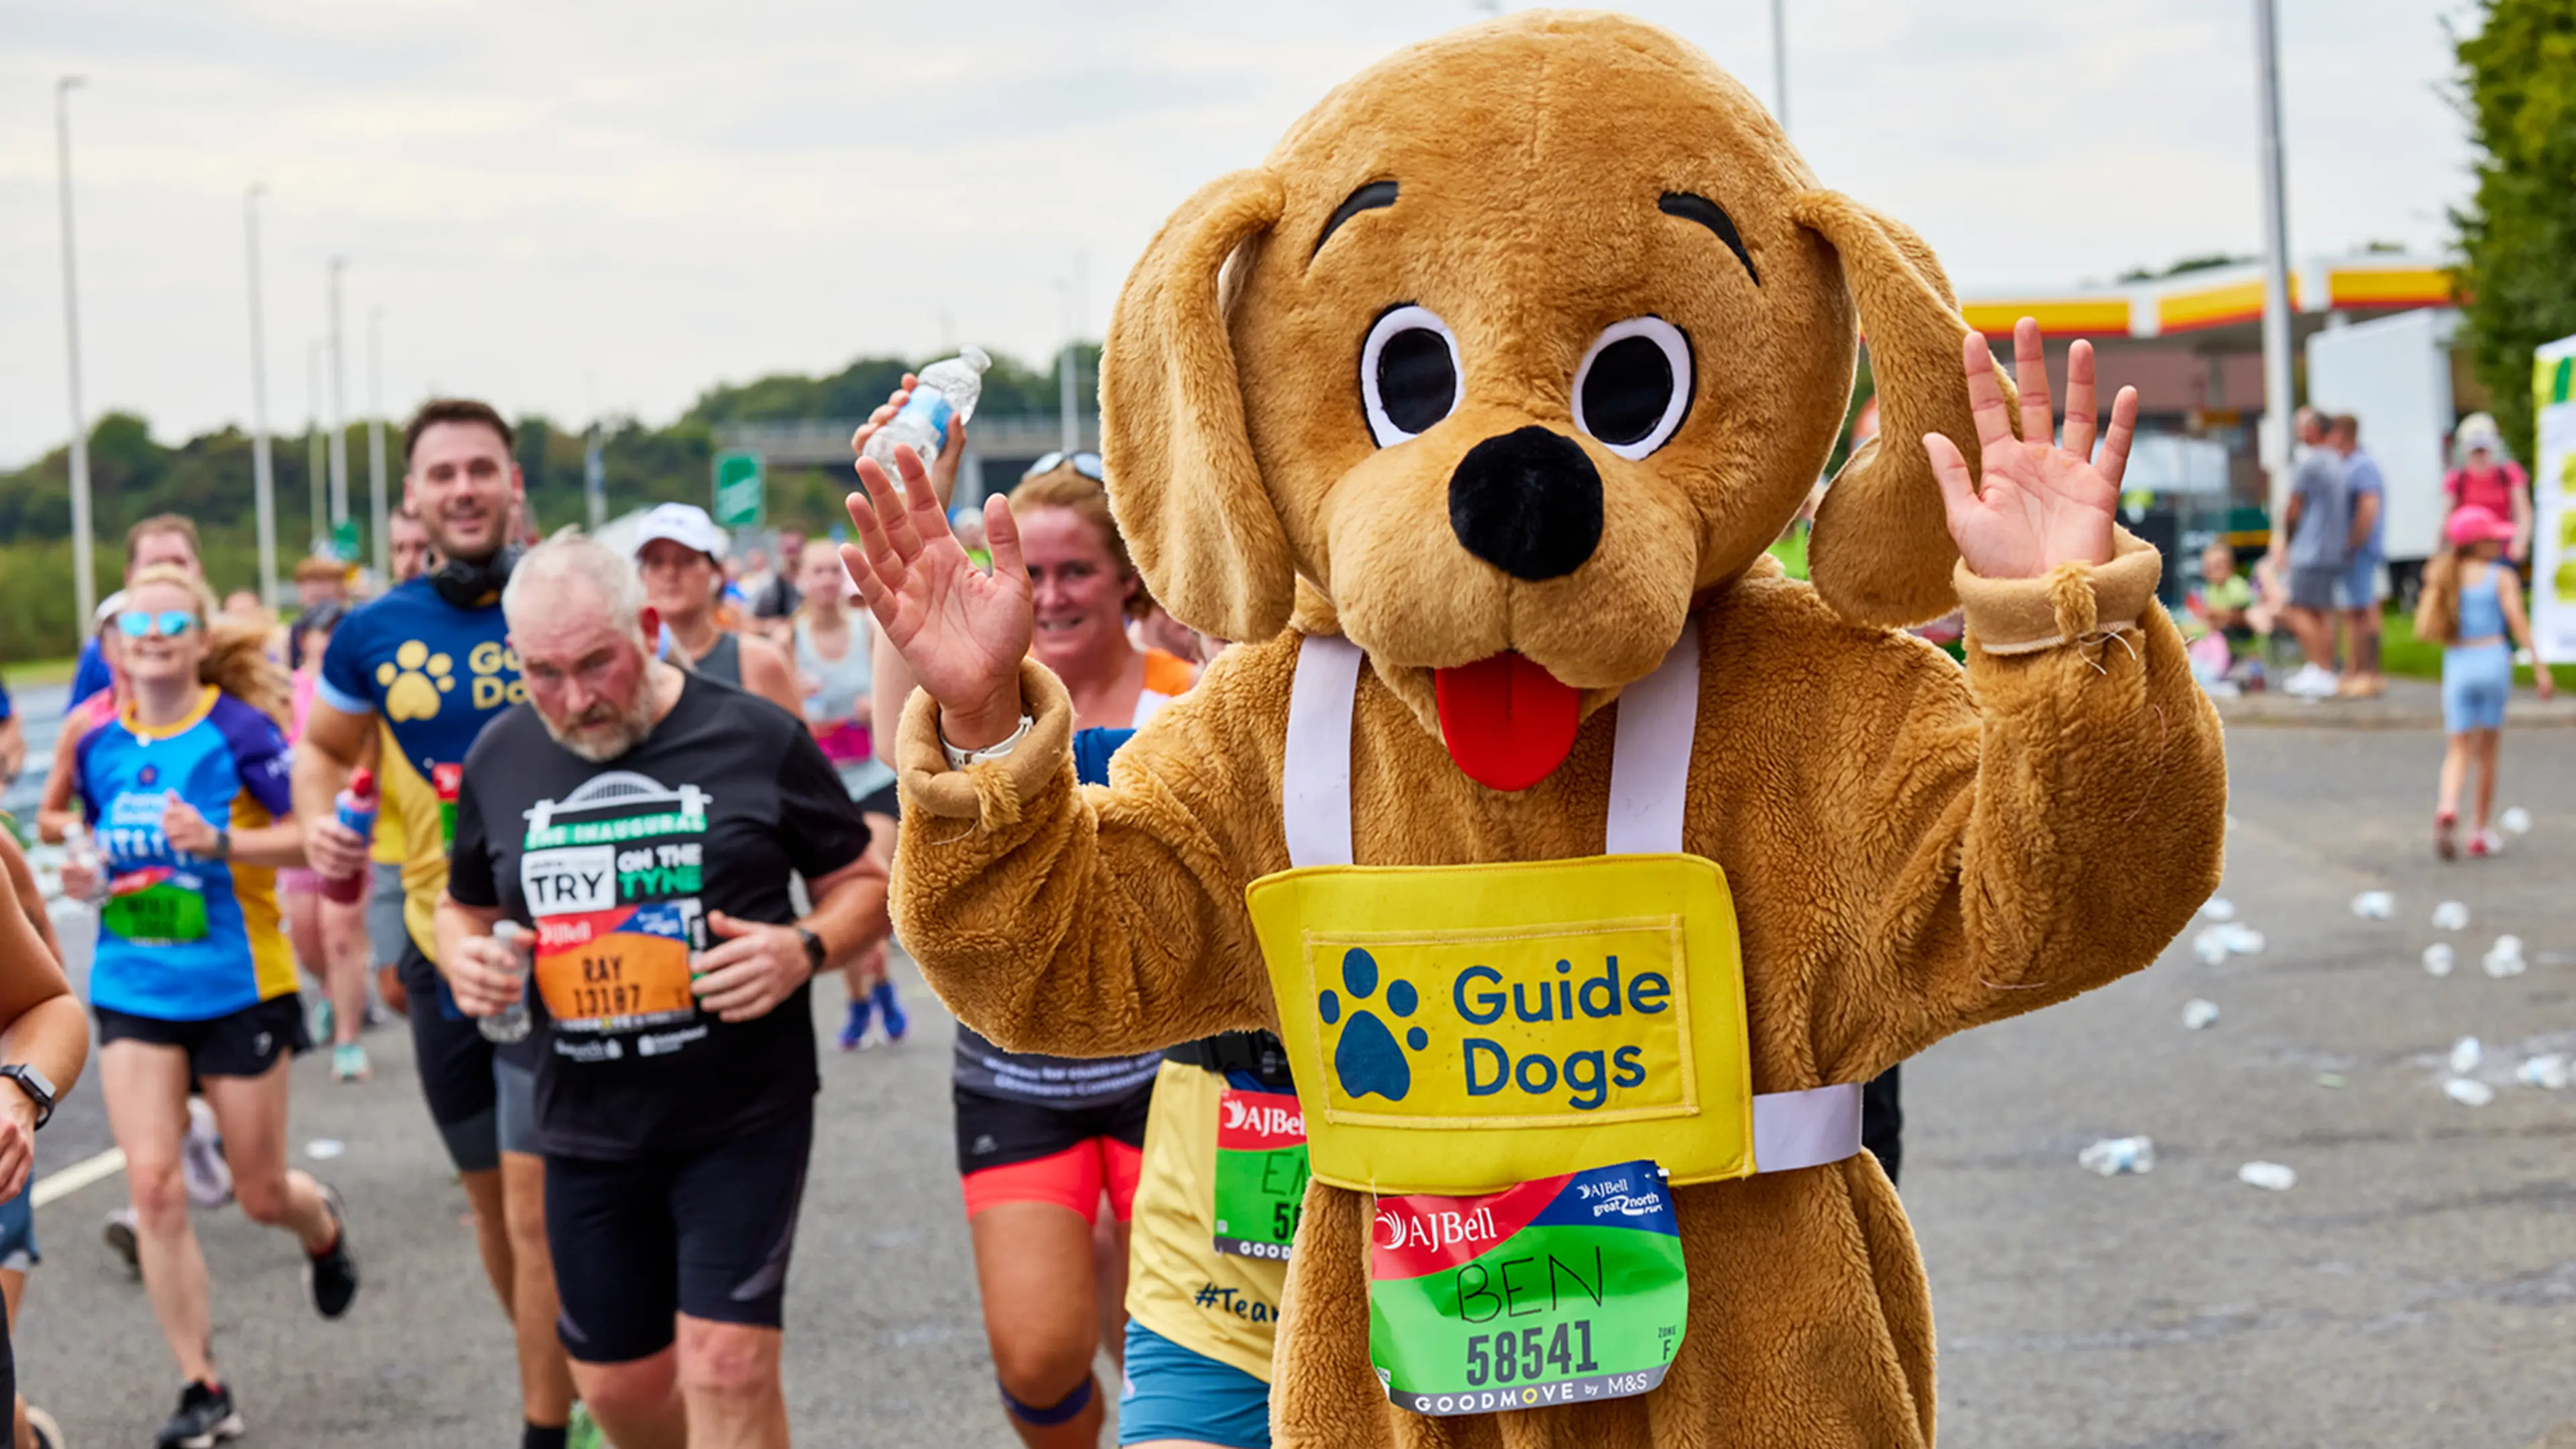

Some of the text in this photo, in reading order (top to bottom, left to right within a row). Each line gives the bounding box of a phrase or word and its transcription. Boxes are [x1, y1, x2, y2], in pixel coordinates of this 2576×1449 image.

[468, 641, 521, 675] Gu
[472, 676, 530, 710] Do
[574, 814, 706, 842] INAUGURAL
[618, 847, 653, 873] ON
[656, 843, 703, 867] THE
[530, 871, 603, 903] TRY
[618, 864, 703, 899] TYNE
[582, 955, 623, 982] RAY
[1453, 955, 1671, 1025] Guide
[1462, 1038, 1646, 1110] Dogs
[1242, 1105, 1305, 1137] AJBel
[1591, 1179, 1628, 1198] AJBell
[1593, 1191, 1660, 1218] great north
[1645, 1203, 1663, 1214] run
[1409, 1208, 1497, 1252] AJBell
[1240, 1241, 1292, 1260] GOOD
[1456, 1246, 1603, 1324] BEN
[1658, 1324, 1676, 1339] ZONE
[1466, 1320, 1599, 1387] 58541
[1663, 1339, 1672, 1361] F
[1415, 1373, 1648, 1412] GOODMOVE by M&S
